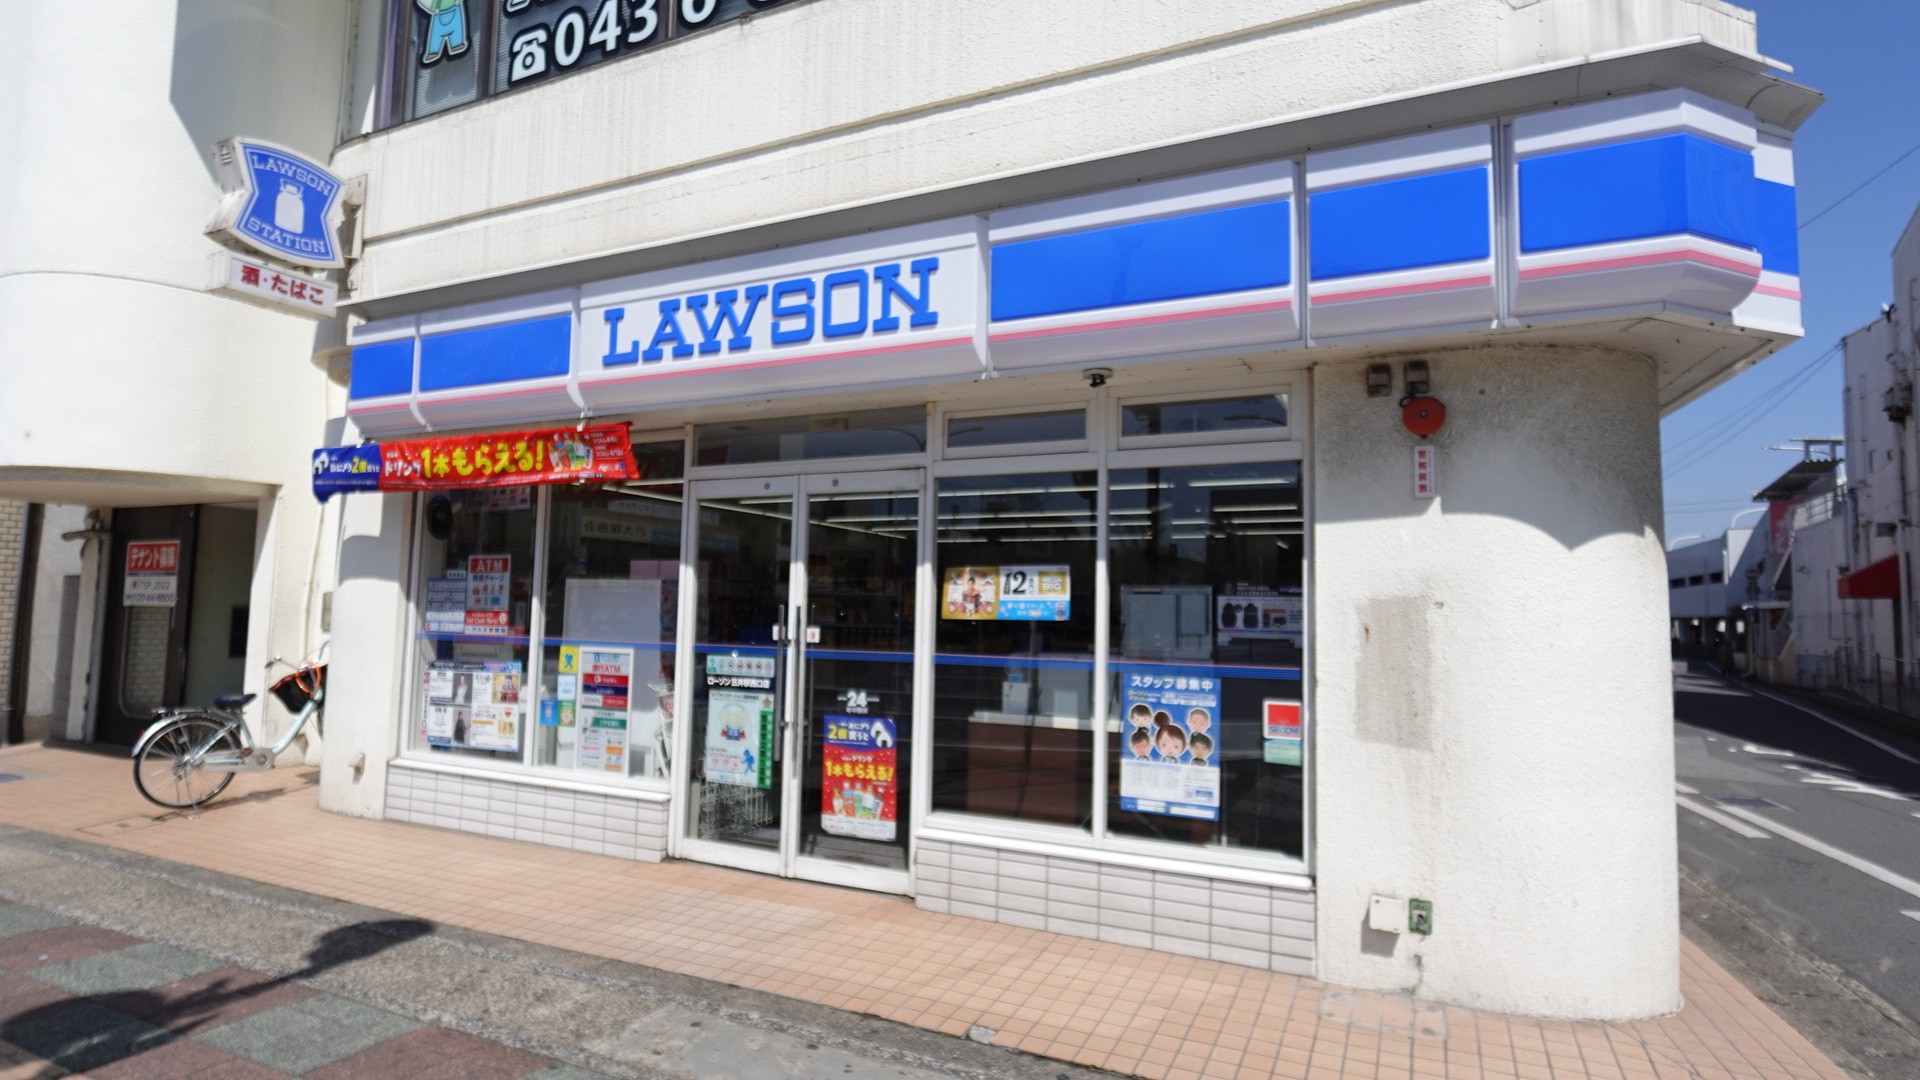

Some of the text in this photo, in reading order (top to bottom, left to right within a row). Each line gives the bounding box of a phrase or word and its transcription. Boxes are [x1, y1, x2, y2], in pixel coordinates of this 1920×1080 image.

[251, 155, 332, 196] LAWSON
[247, 216, 327, 254] STATION
[240, 264, 324, 305] 酒・たばこ
[602, 256, 939, 368] LAWSON
[476, 559, 503, 573] ATM
[1042, 583, 1062, 591] BIG
[1131, 675, 1214, 692] スタッフ募集中
[825, 759, 894, 782] 1本もらえる!
